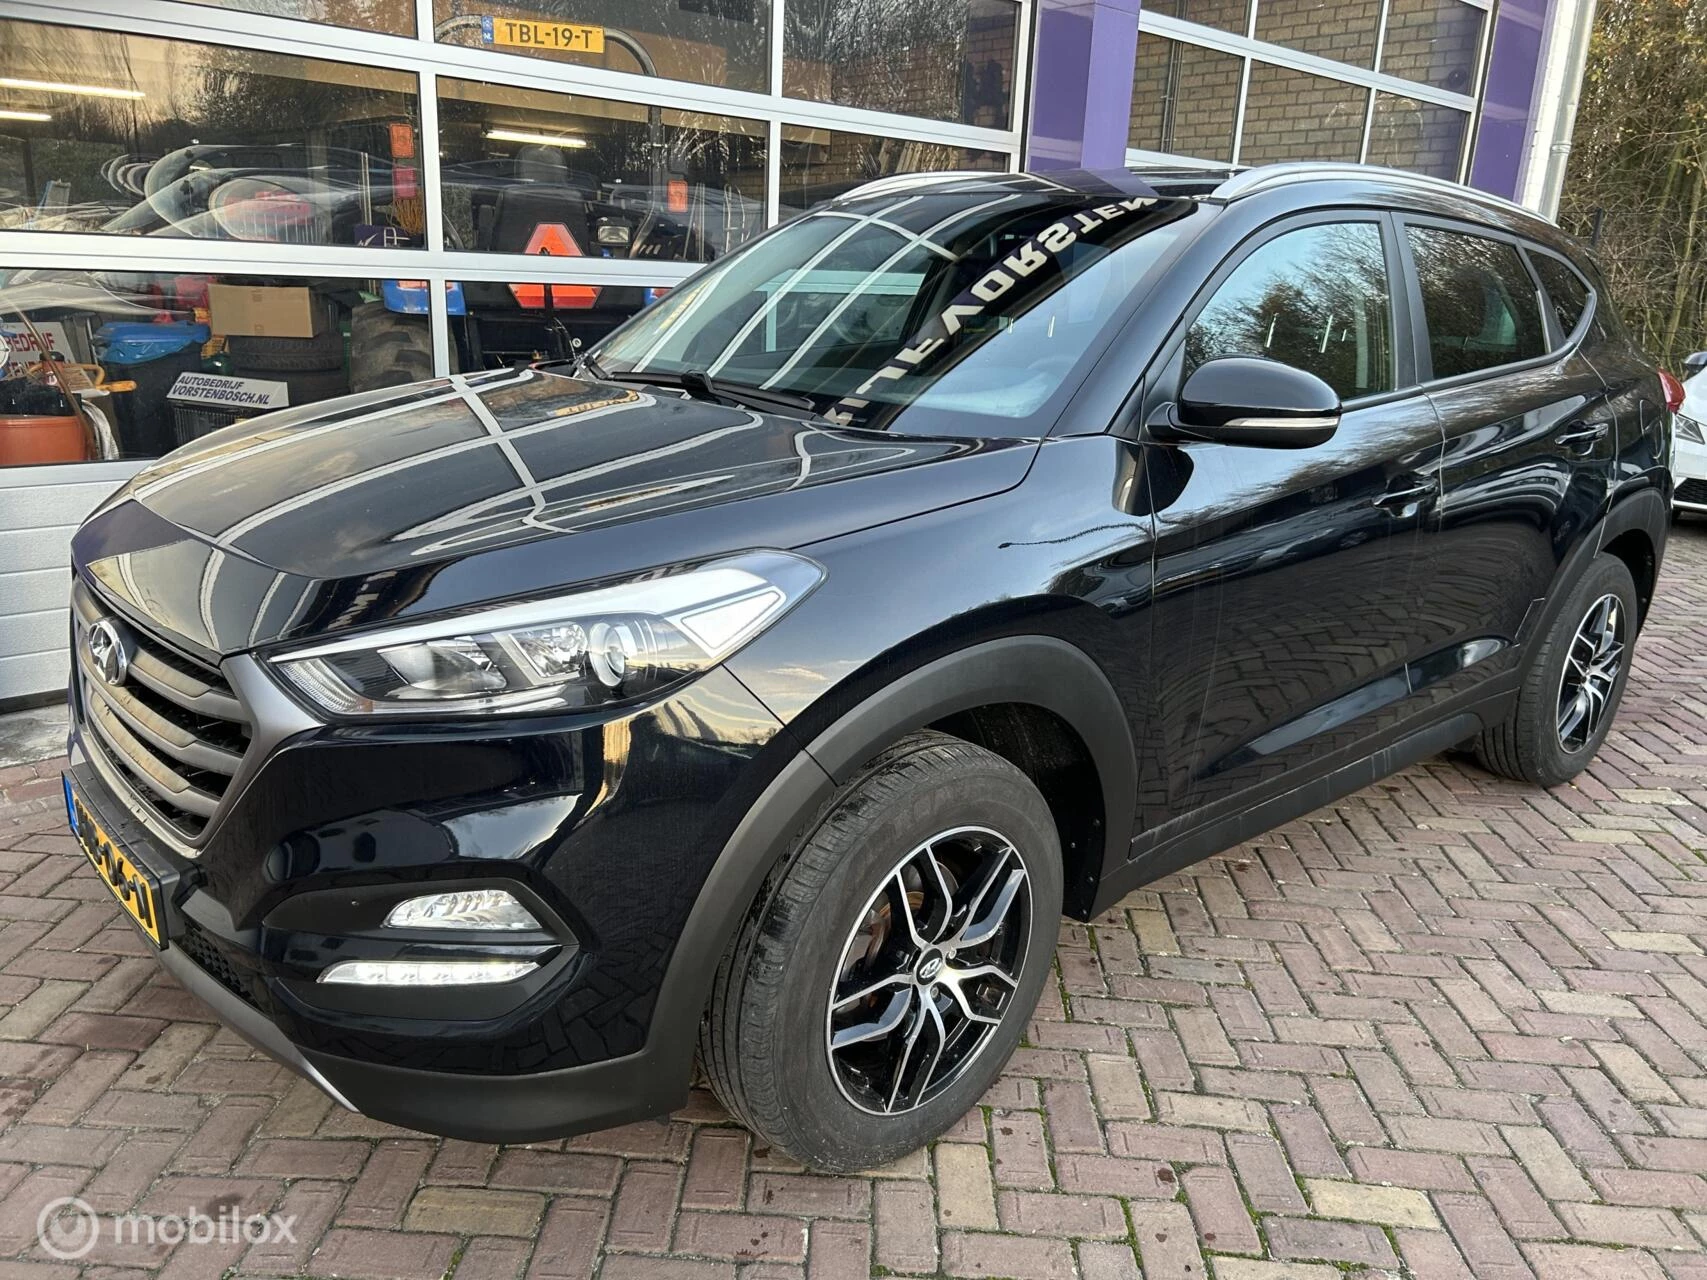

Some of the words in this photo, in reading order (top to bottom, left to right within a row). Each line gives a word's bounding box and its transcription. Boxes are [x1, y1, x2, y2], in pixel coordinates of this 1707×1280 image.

[505, 22, 593, 49] TBL-19-T
[178, 375, 244, 390] AUTOBEDRIJF
[172, 384, 270, 405] VORSTENBOSCH.NL
